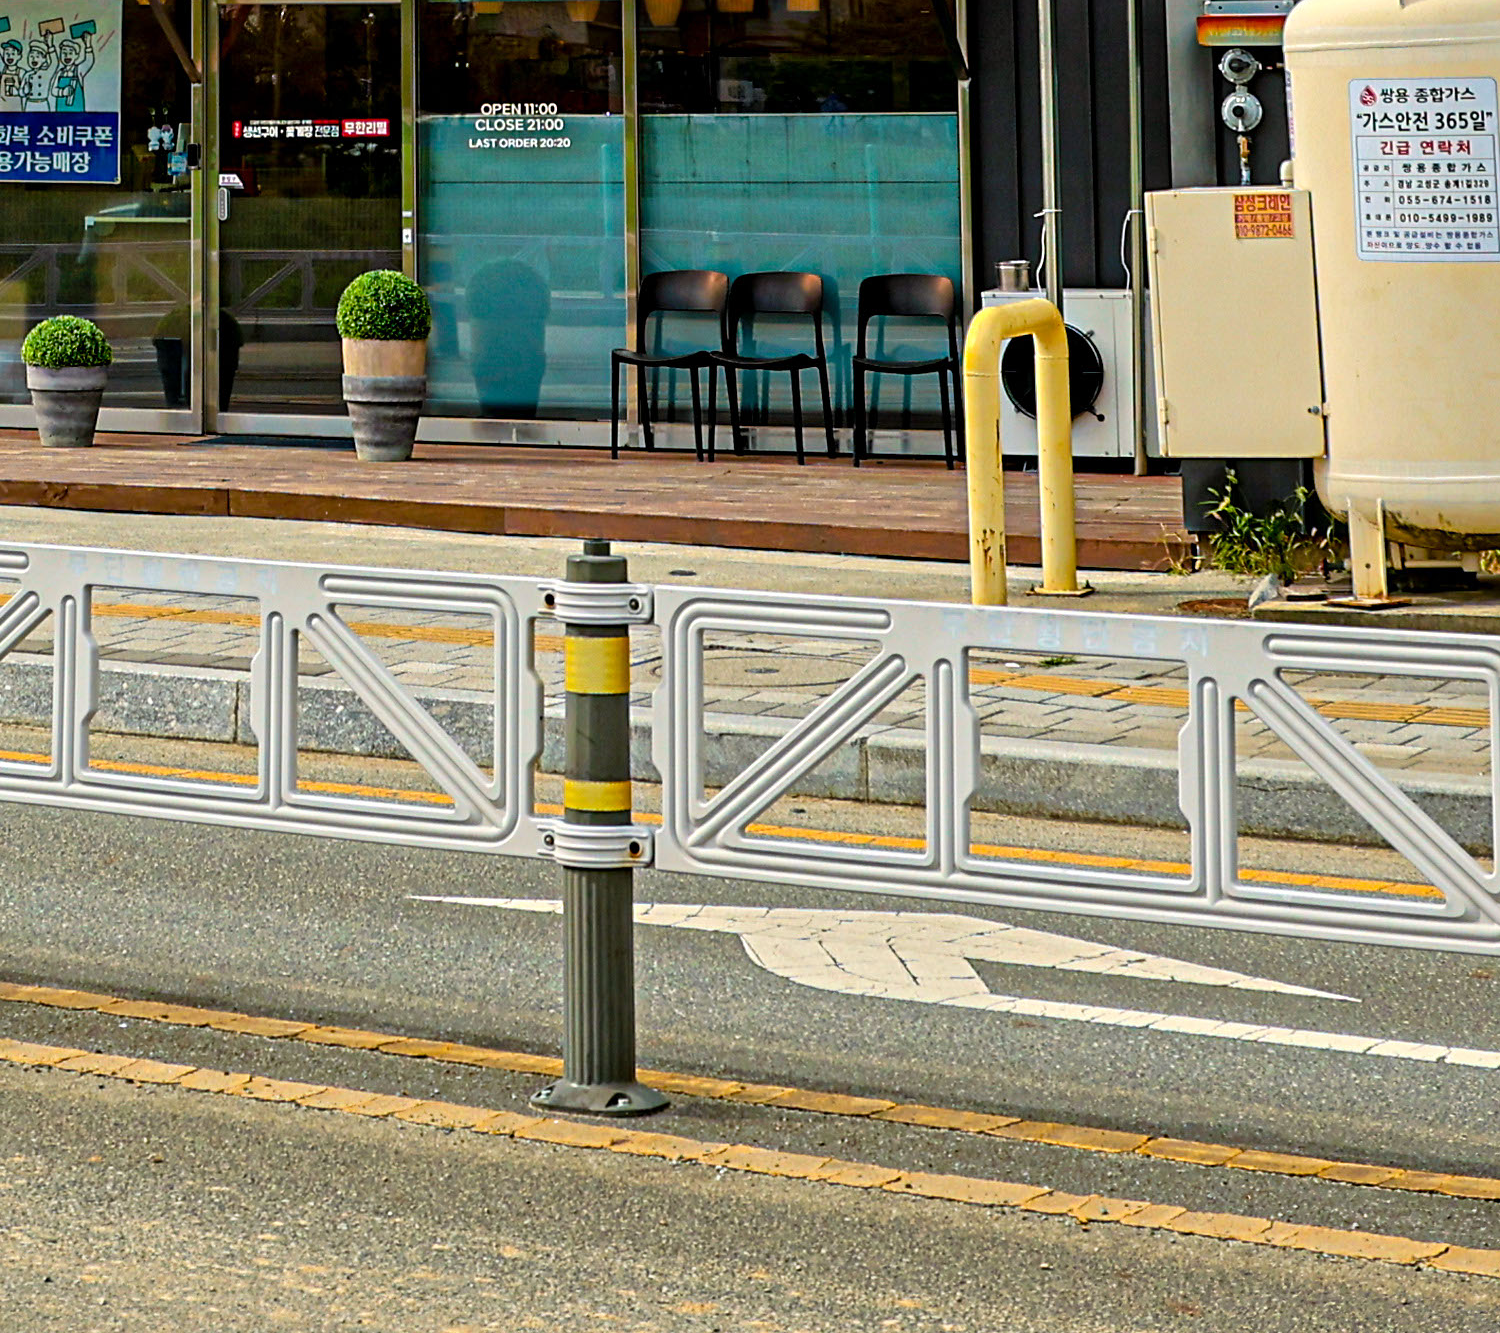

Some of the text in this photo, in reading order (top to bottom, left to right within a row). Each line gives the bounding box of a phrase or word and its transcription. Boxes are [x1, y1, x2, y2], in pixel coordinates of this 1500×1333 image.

[1380, 87, 1476, 104] 쌍용 종합가스
[480, 102, 558, 115] OPEN 11:00
[475, 118, 564, 131] CLOSE 21:00
[36, 125, 114, 147] 소비쿠폰
[468, 137, 571, 148] LAST ORDER 20:20
[1380, 140, 1472, 156] 긴급 연락처
[1398, 194, 1492, 206] 055-674-1518
